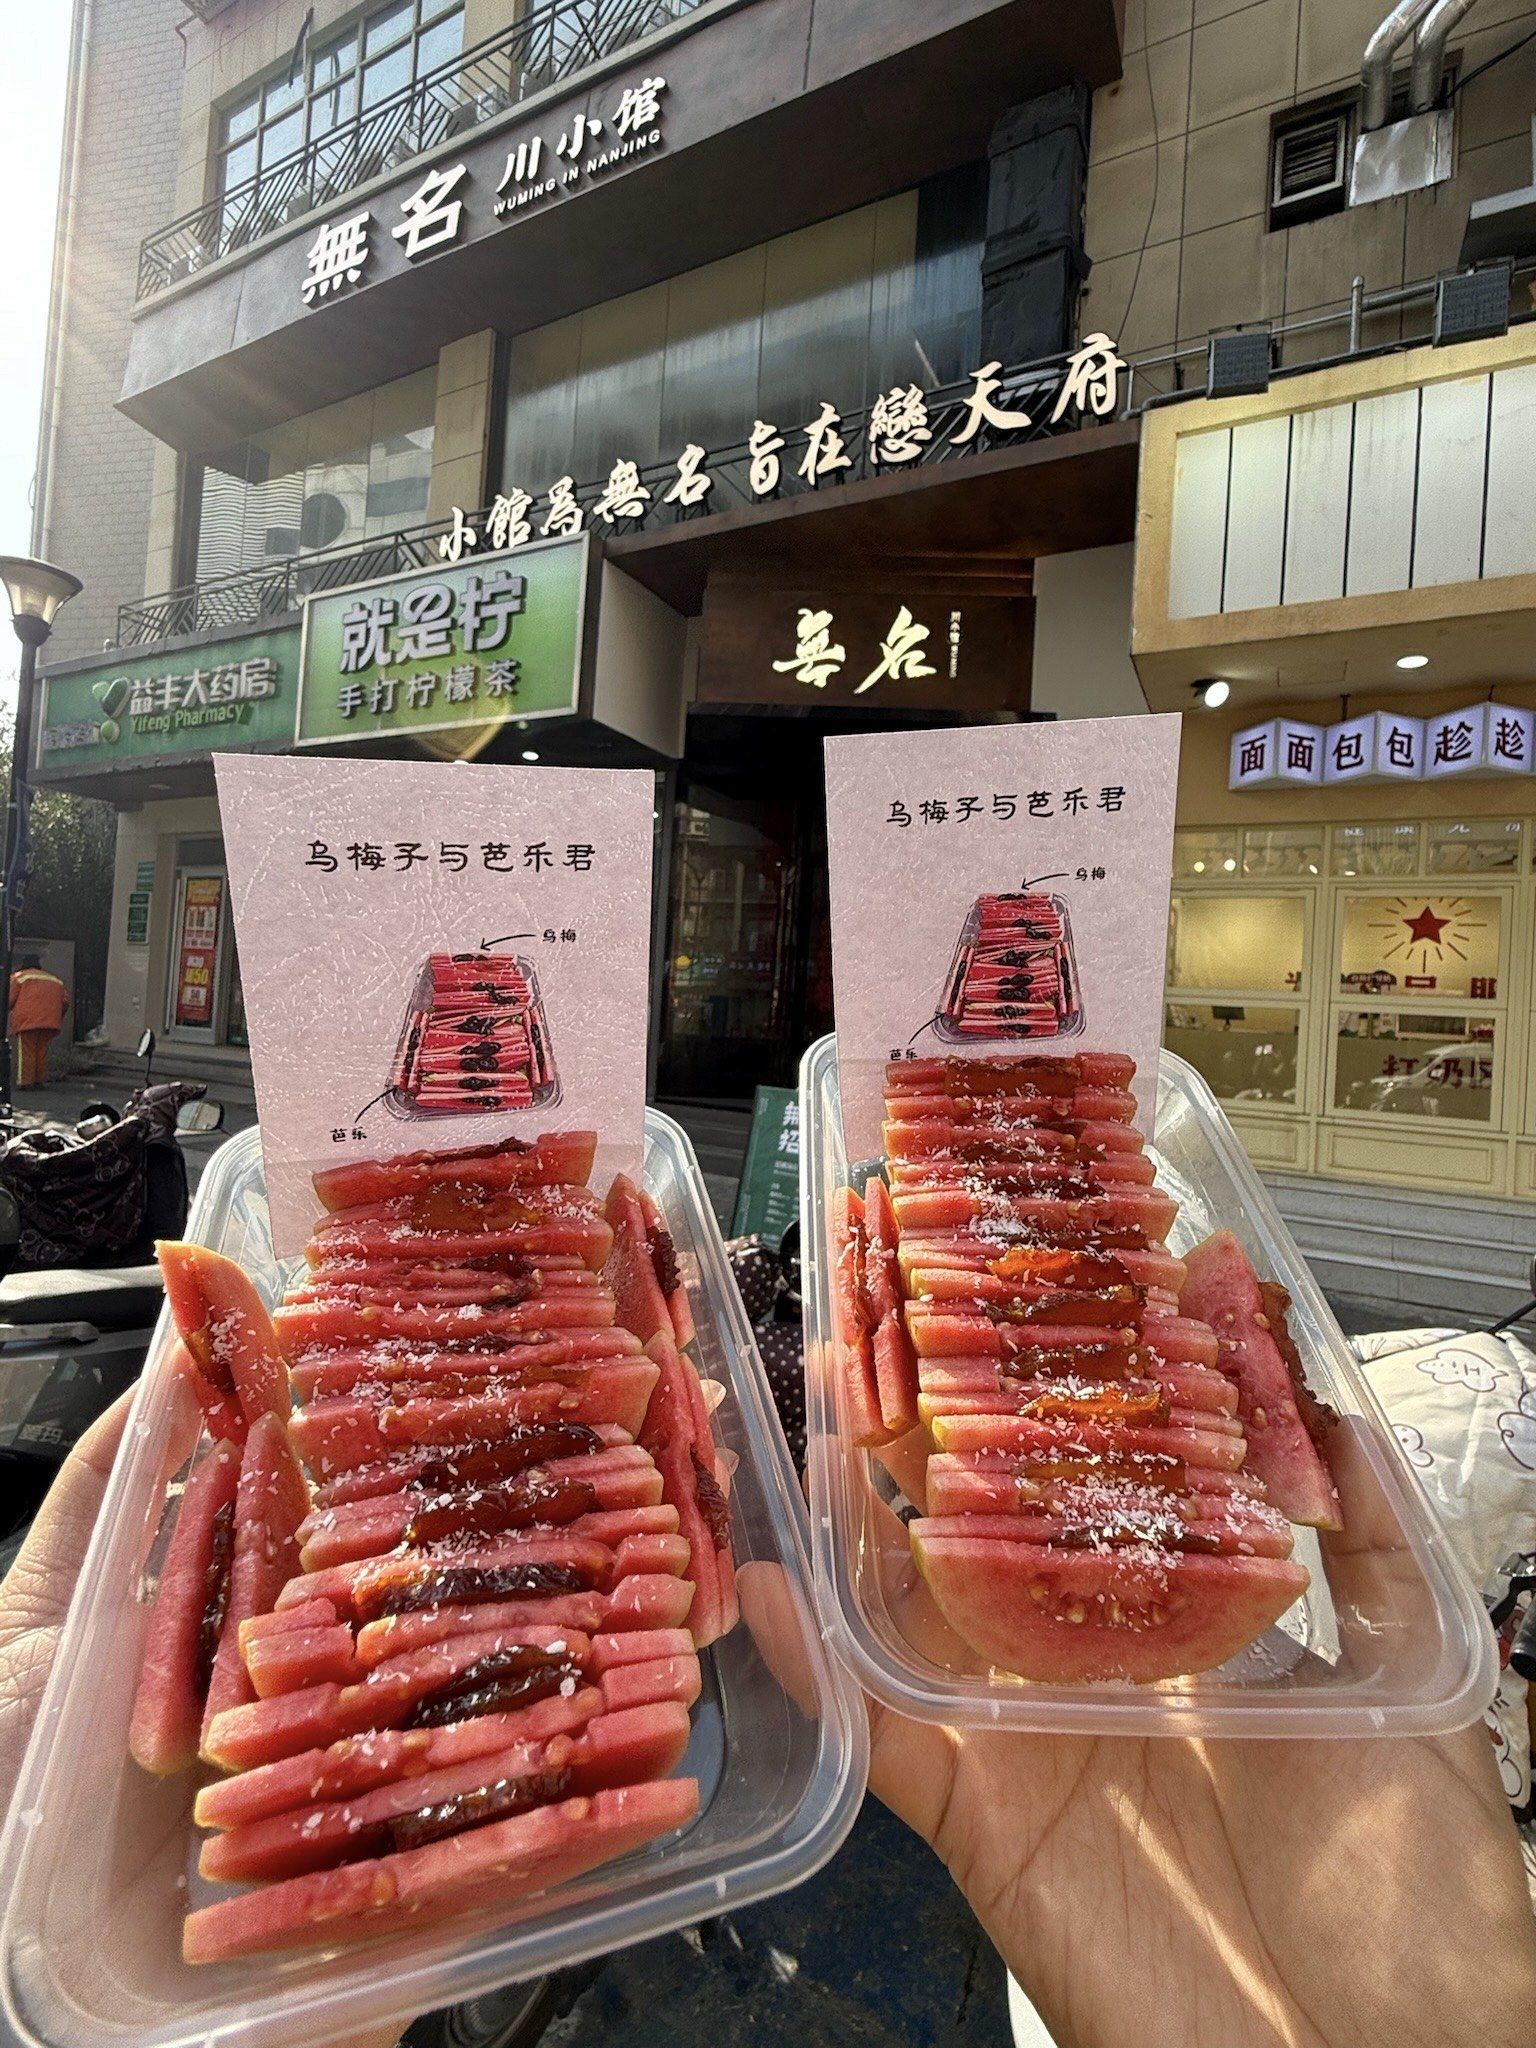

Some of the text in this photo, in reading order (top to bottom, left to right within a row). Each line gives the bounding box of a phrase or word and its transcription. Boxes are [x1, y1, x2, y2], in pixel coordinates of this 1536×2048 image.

[301, 76, 667, 304] 無名 川小馆
[493, 129, 661, 216] WUMING IN NANJING
[340, 570, 524, 673] 就是柠
[129, 656, 277, 716] 益丰大药房
[336, 658, 520, 718] 手打柠檬茶
[131, 701, 245, 734] Yifeng Pharmacy
[886, 786, 1127, 828] 乌梅子与芭乐君
[305, 839, 597, 873] 乌梅子与芭乐君
[1074, 867, 1106, 882] 乌梅
[541, 928, 578, 943] 乌梅
